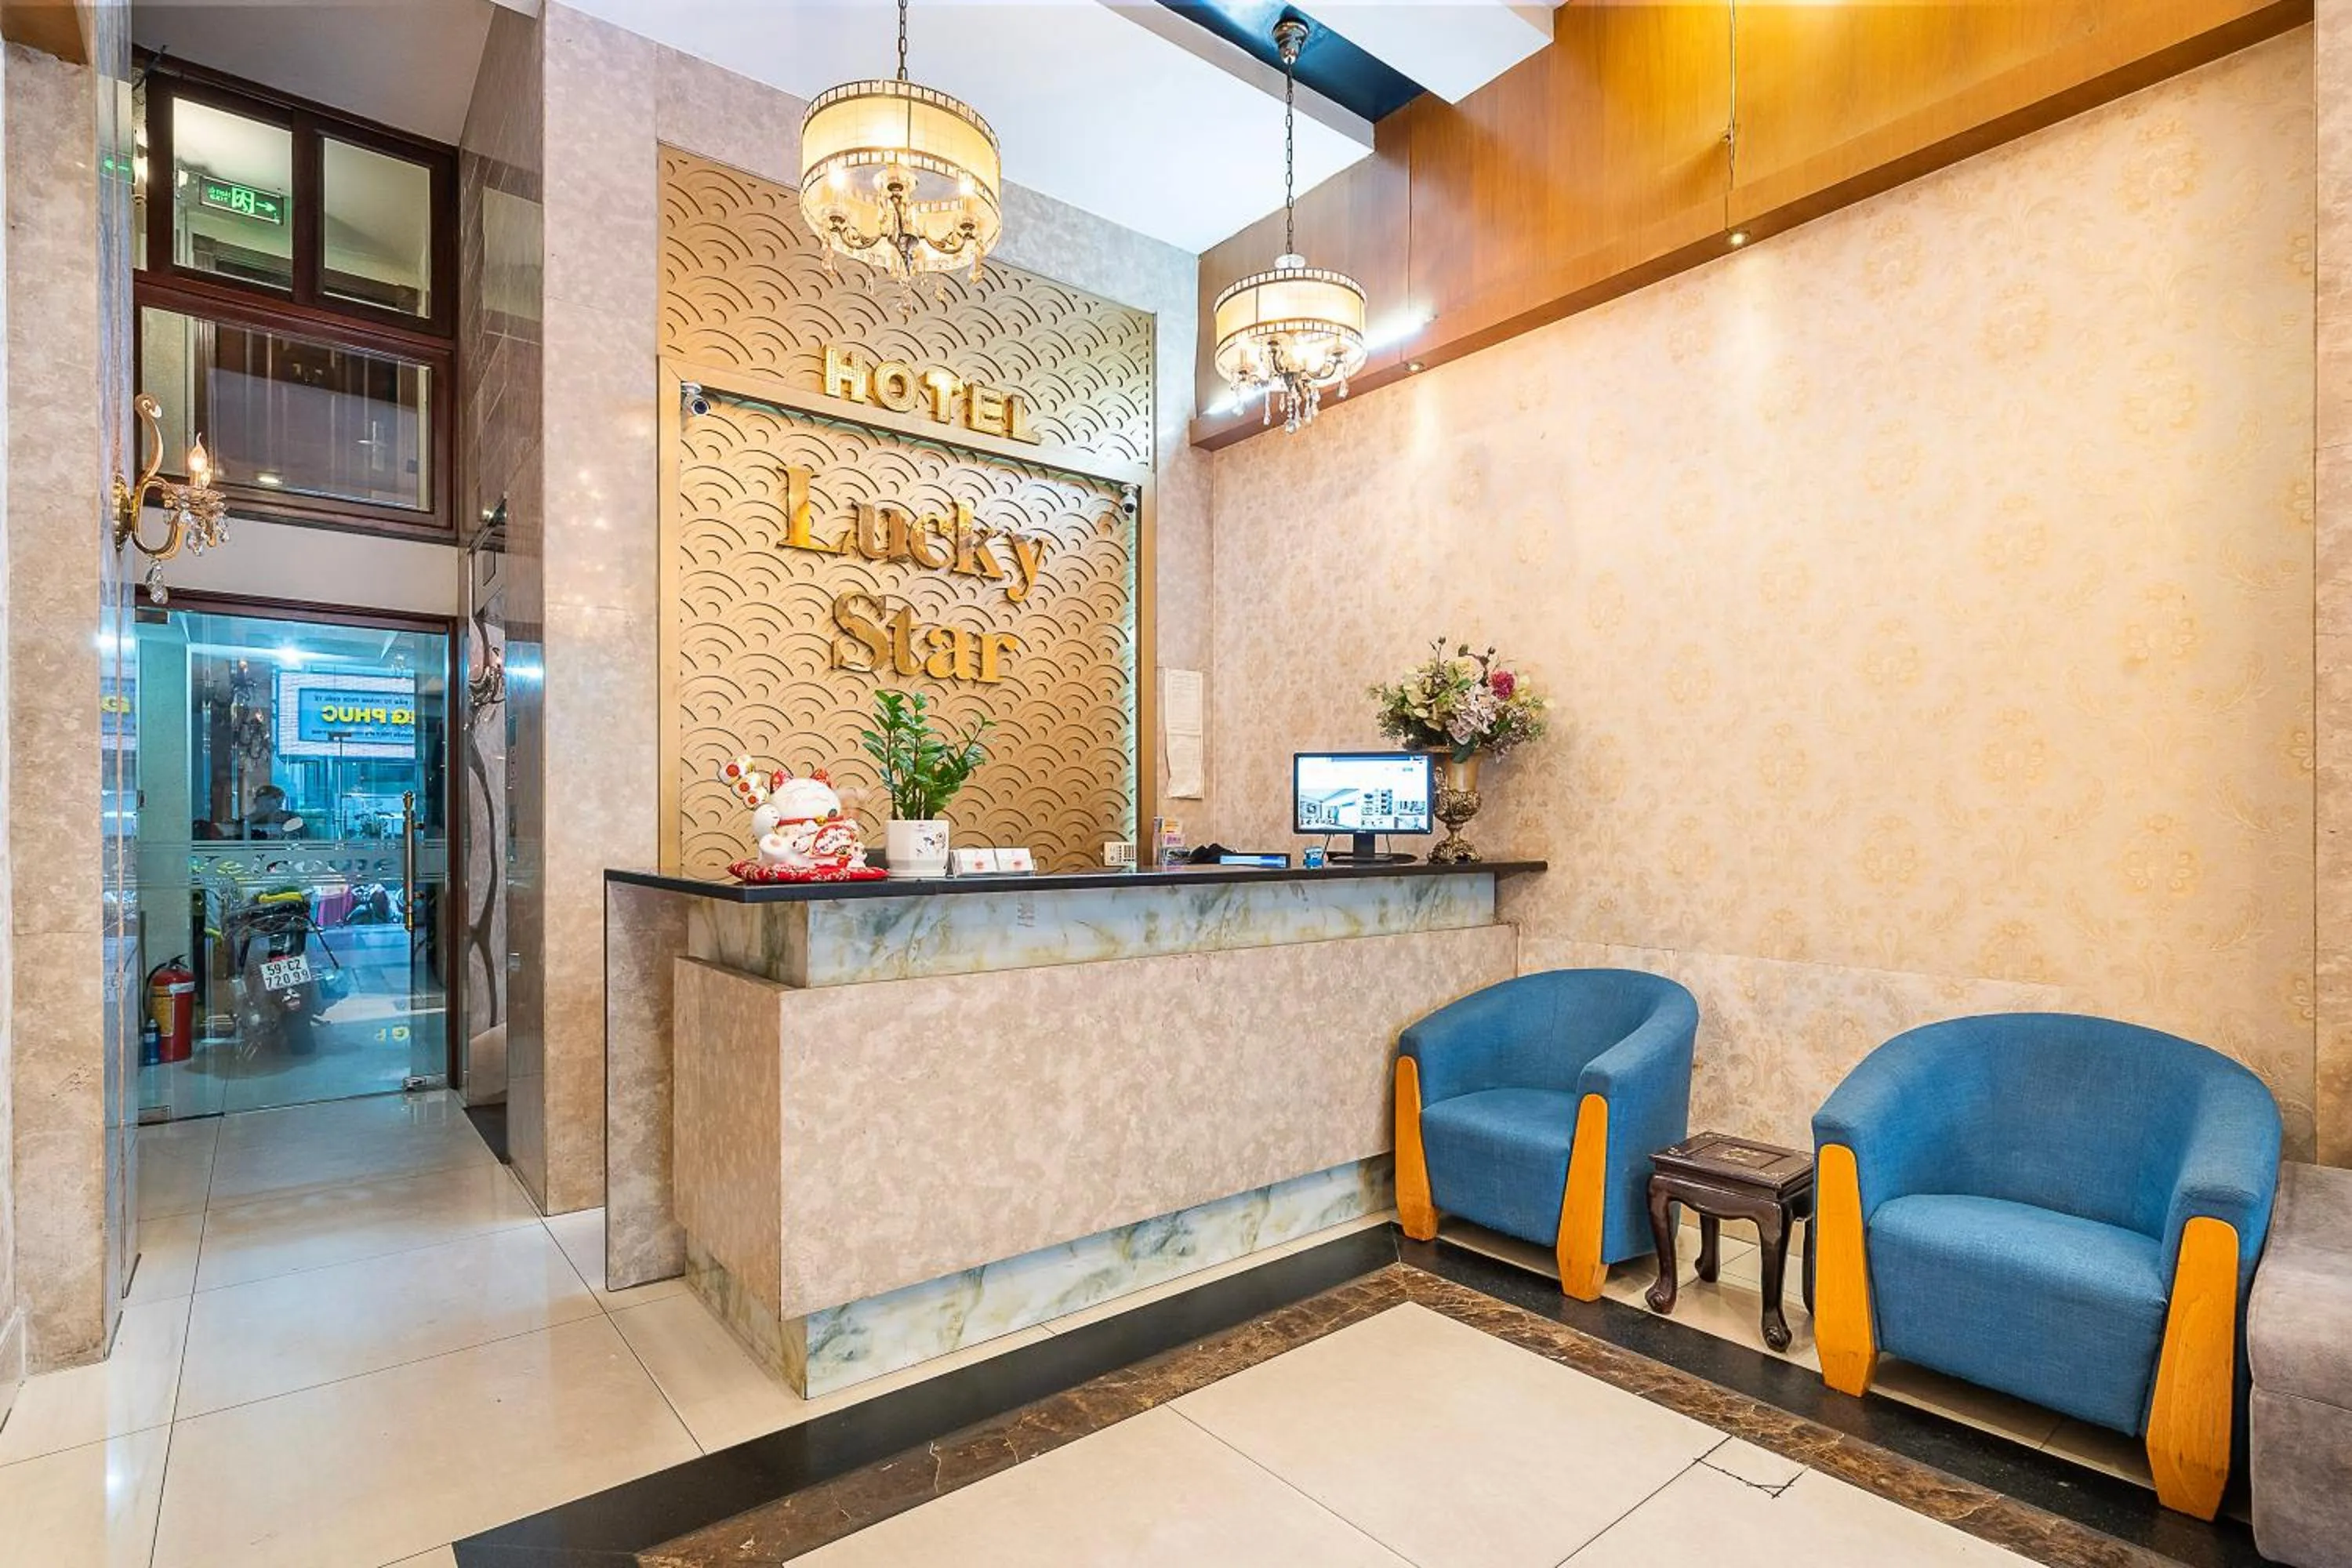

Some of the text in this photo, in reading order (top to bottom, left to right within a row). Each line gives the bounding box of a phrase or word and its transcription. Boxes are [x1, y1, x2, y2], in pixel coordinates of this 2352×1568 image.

[822, 343, 1043, 446] HOTEL
[775, 464, 1053, 603] Lucky
[831, 590, 1021, 684] Star
[267, 959, 302, 976] 59-C2
